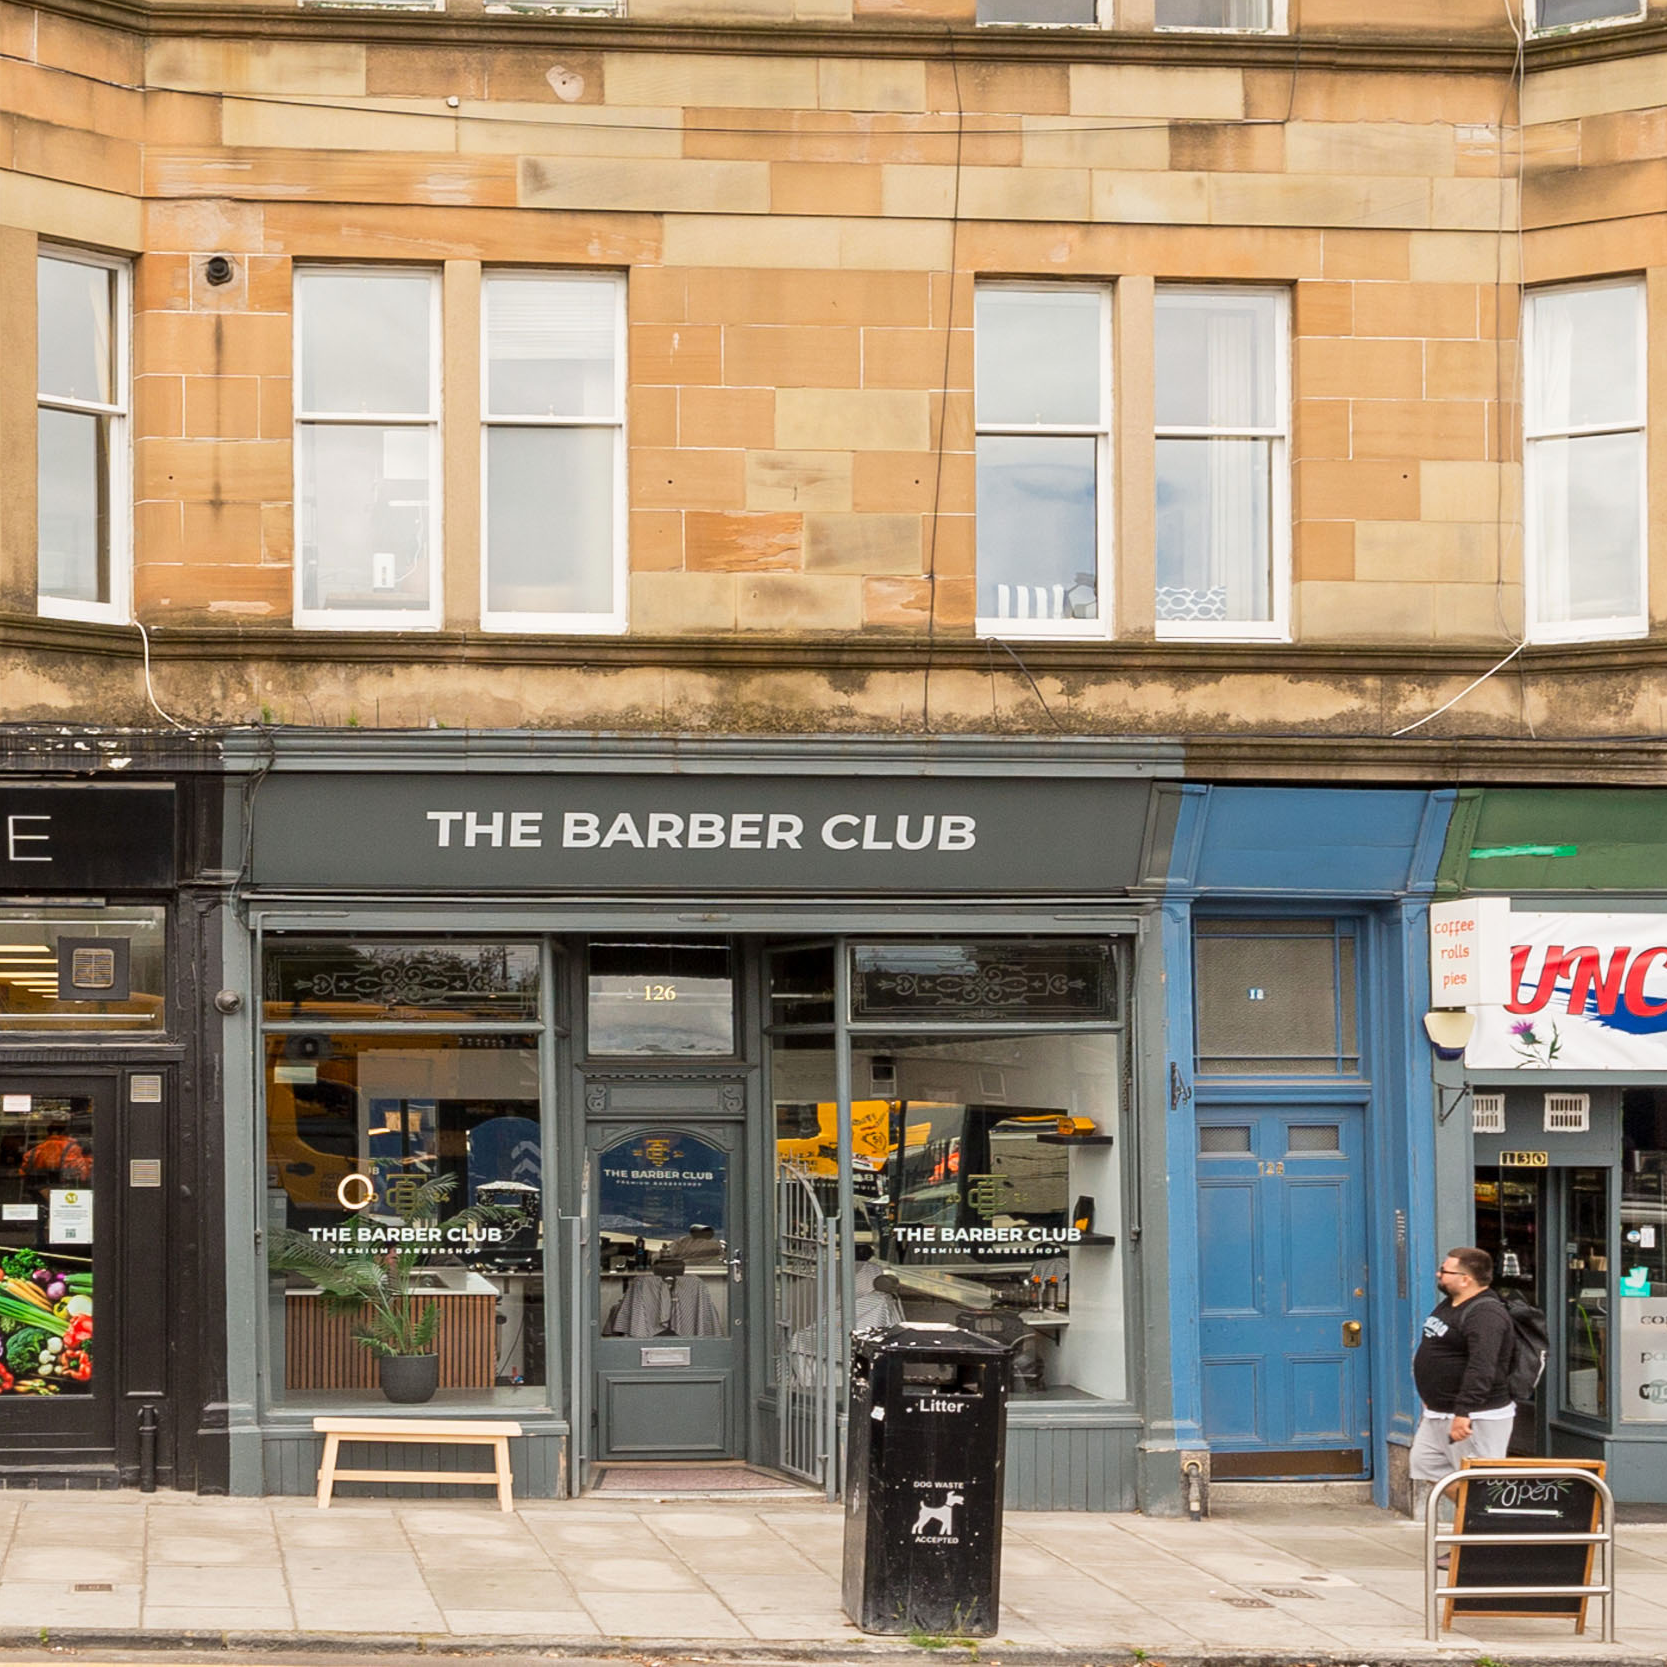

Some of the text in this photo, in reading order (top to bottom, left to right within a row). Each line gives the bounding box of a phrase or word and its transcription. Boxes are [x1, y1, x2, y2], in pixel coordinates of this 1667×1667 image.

[427, 811, 977, 851] THE BARBER CLUB
[1434, 919, 1475, 937] coffee
[1440, 944, 1470, 959] rolls
[1443, 972, 1468, 990] pies
[643, 985, 677, 1001] 126
[1502, 1153, 1546, 1166] 130
[604, 1168, 713, 1180] THE BARBER CLUB
[308, 1227, 503, 1242] THE BARBER CLUB
[893, 1227, 1082, 1243] THE BARBER CLUB
[396, 1247, 481, 1255] BARBERSHOP
[978, 1247, 1062, 1255] BARBERSHOP
[920, 1399, 965, 1413] Litter
[915, 1536, 959, 1544] ACCEPTED
